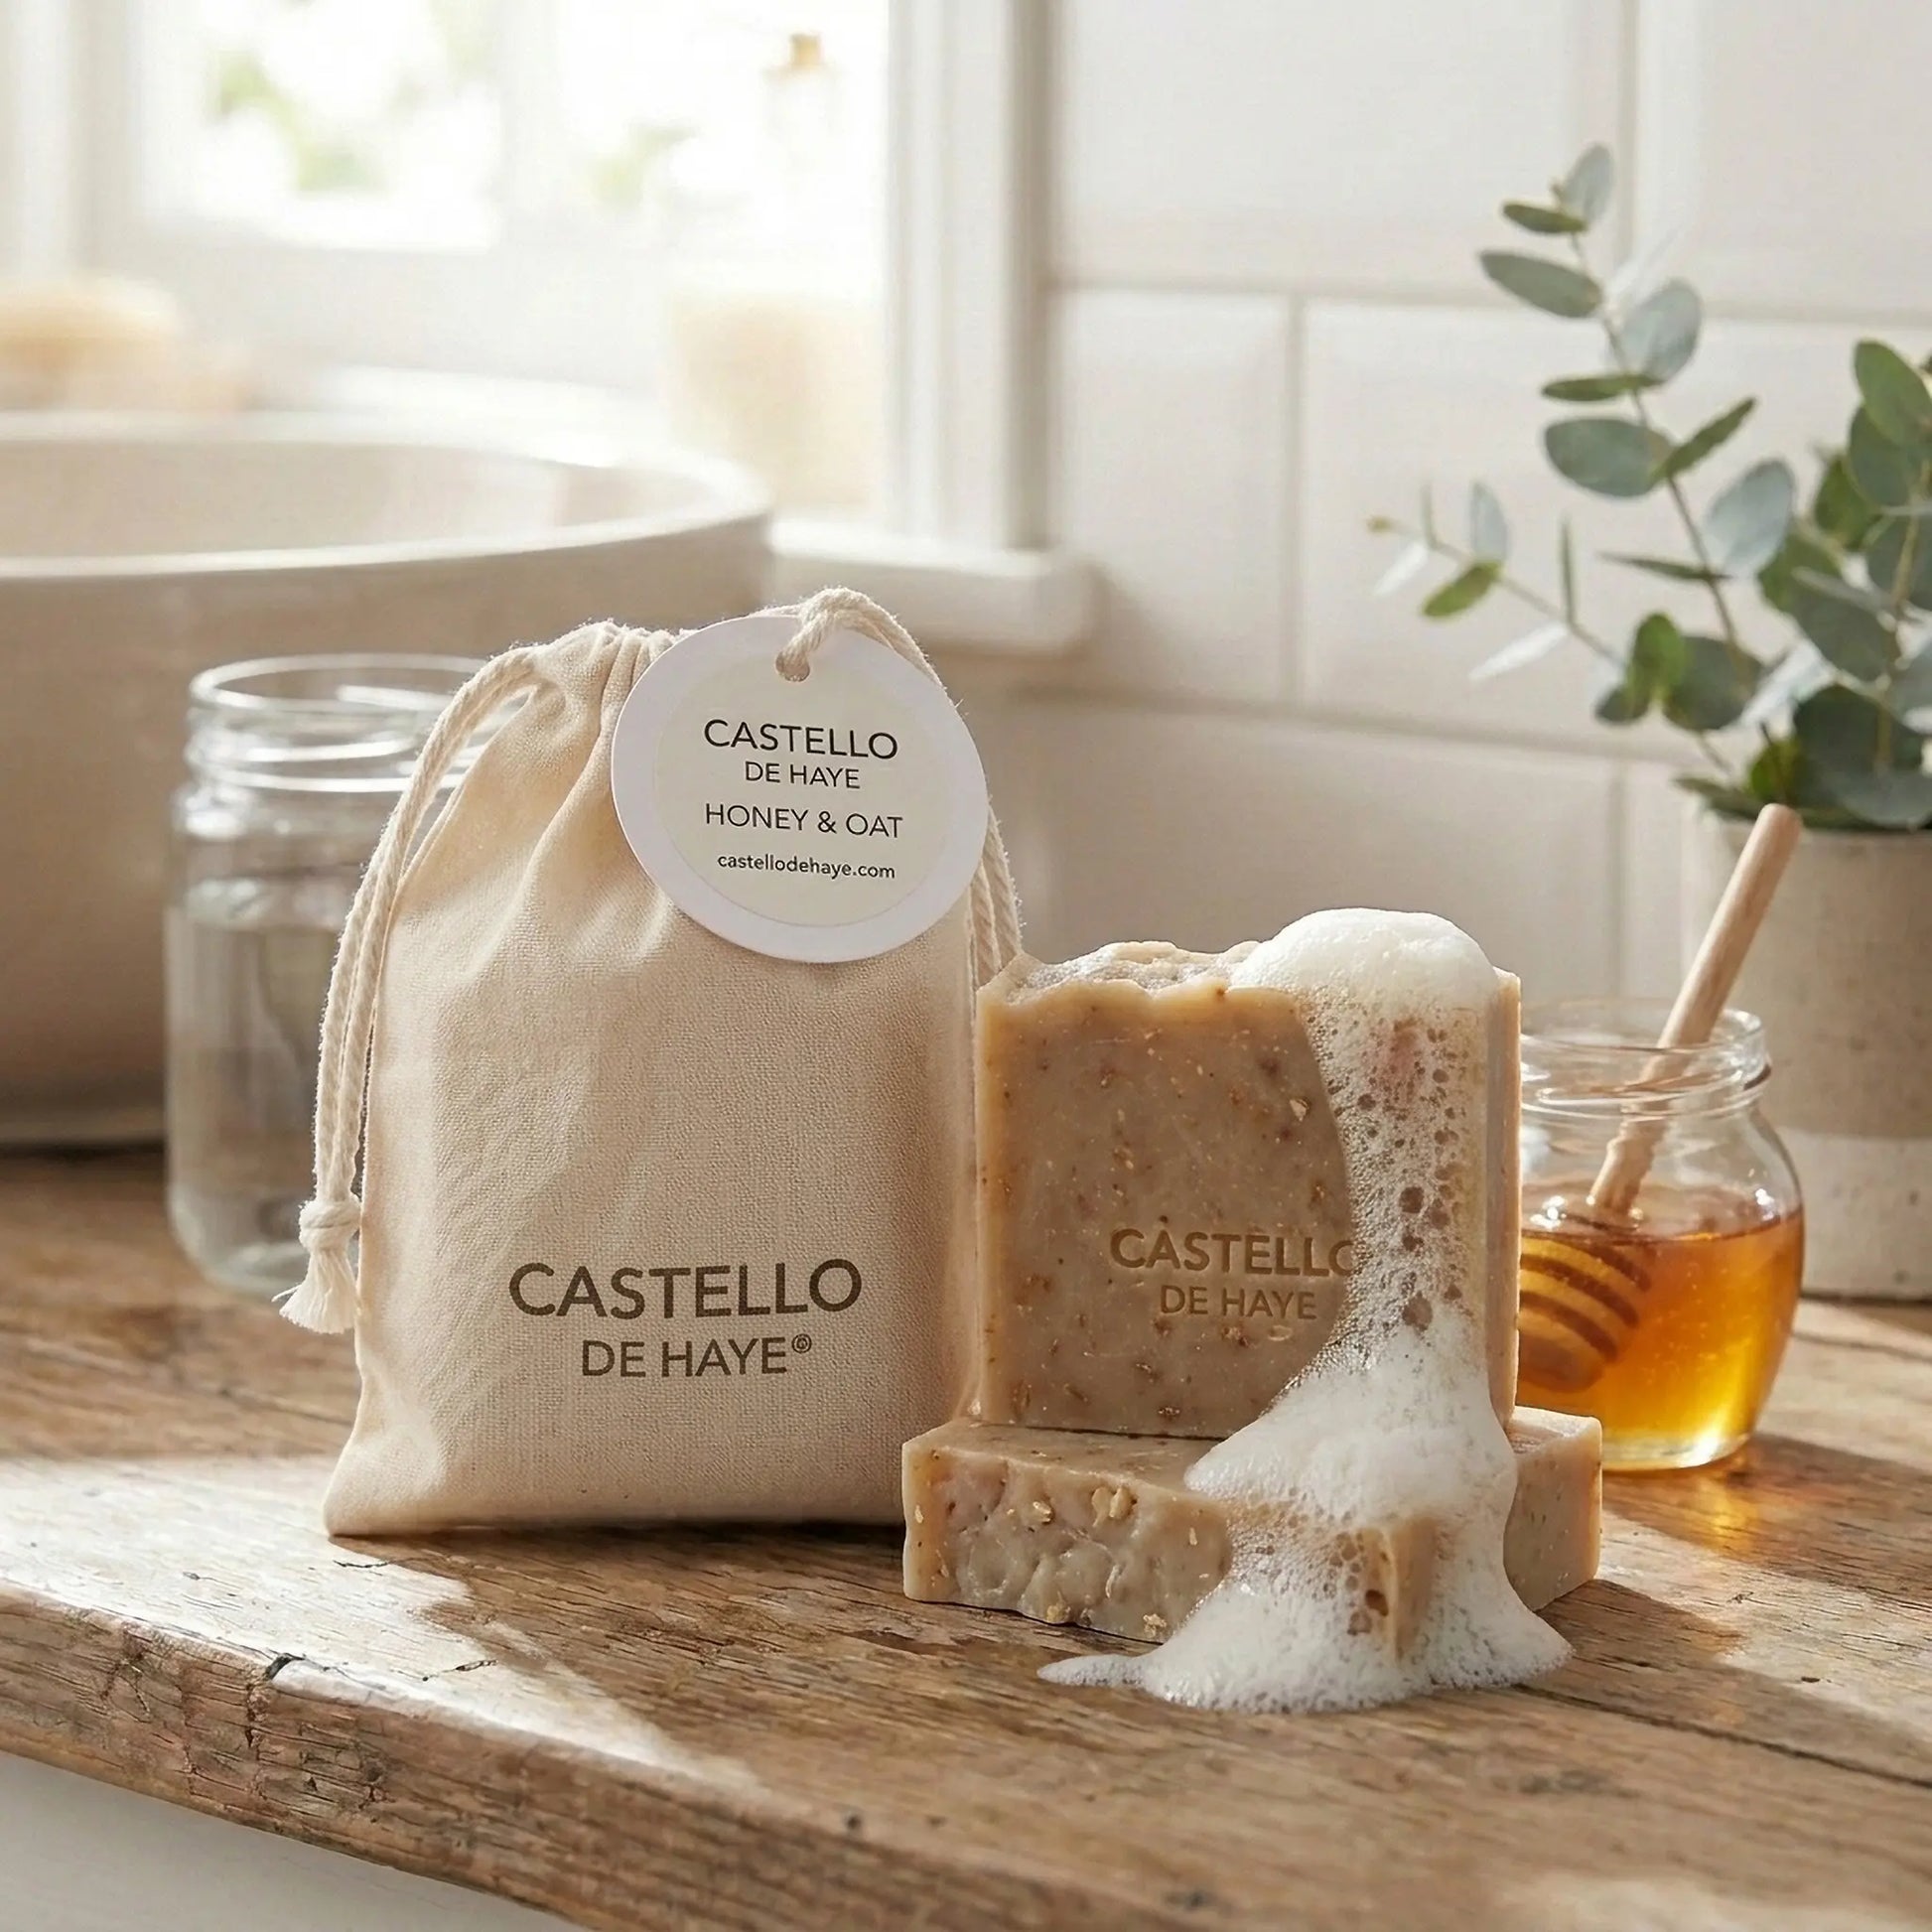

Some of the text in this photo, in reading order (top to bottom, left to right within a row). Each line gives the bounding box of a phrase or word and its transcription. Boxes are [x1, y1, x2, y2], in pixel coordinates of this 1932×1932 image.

[704, 719, 898, 759] CASTELLO
[745, 760, 861, 789] DE HAYE
[705, 803, 903, 838] HONEY & OAT
[717, 853, 896, 880] castellodehaye.com
[508, 1258, 863, 1320] CASTELLO
[1160, 1285, 1317, 1320] DE HAYE
[582, 1339, 646, 1378] DE
